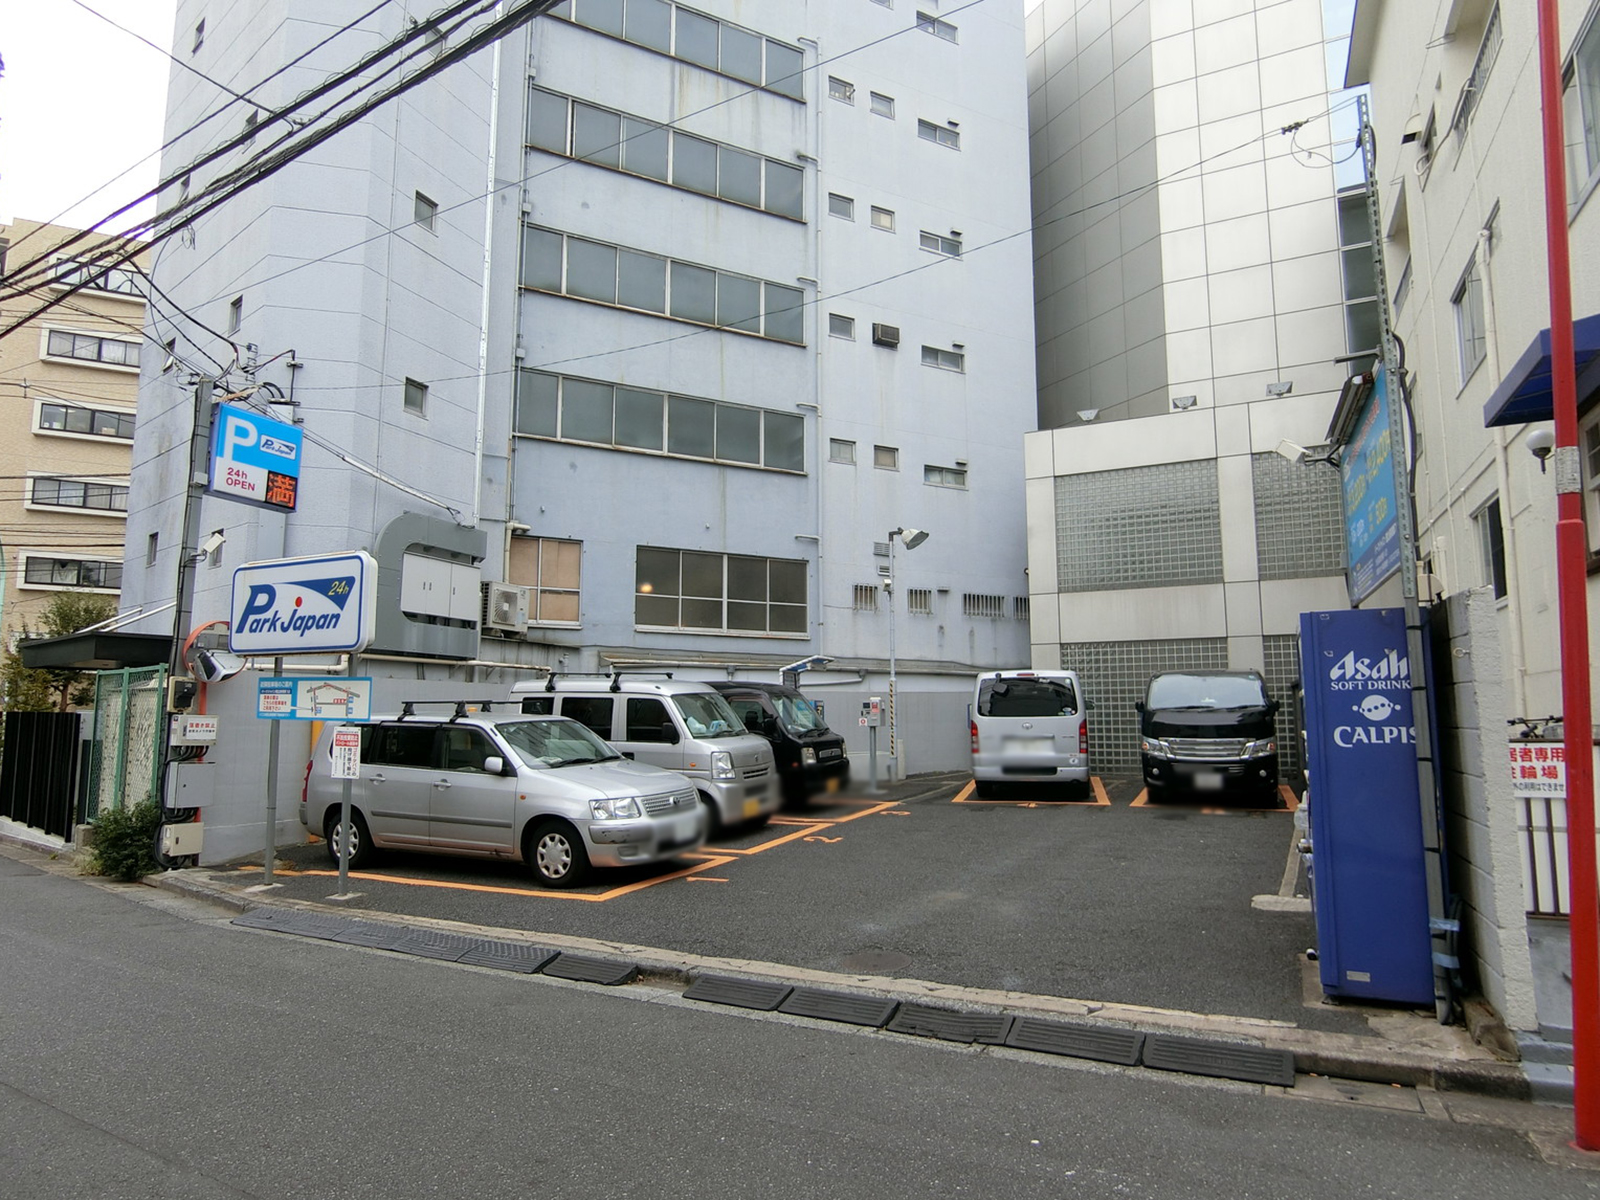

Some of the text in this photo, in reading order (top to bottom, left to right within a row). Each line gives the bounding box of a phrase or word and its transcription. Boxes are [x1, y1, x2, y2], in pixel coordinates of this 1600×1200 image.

[223, 415, 258, 461] P
[227, 467, 248, 480] 24h
[226, 477, 256, 492] OPEN
[267, 473, 296, 508] 満
[327, 580, 350, 596] 24h
[235, 584, 341, 638] Park Japan
[1329, 649, 1409, 681] Asah
[1331, 680, 1413, 691] SOFT DRINK
[803, 835, 844, 843] 2
